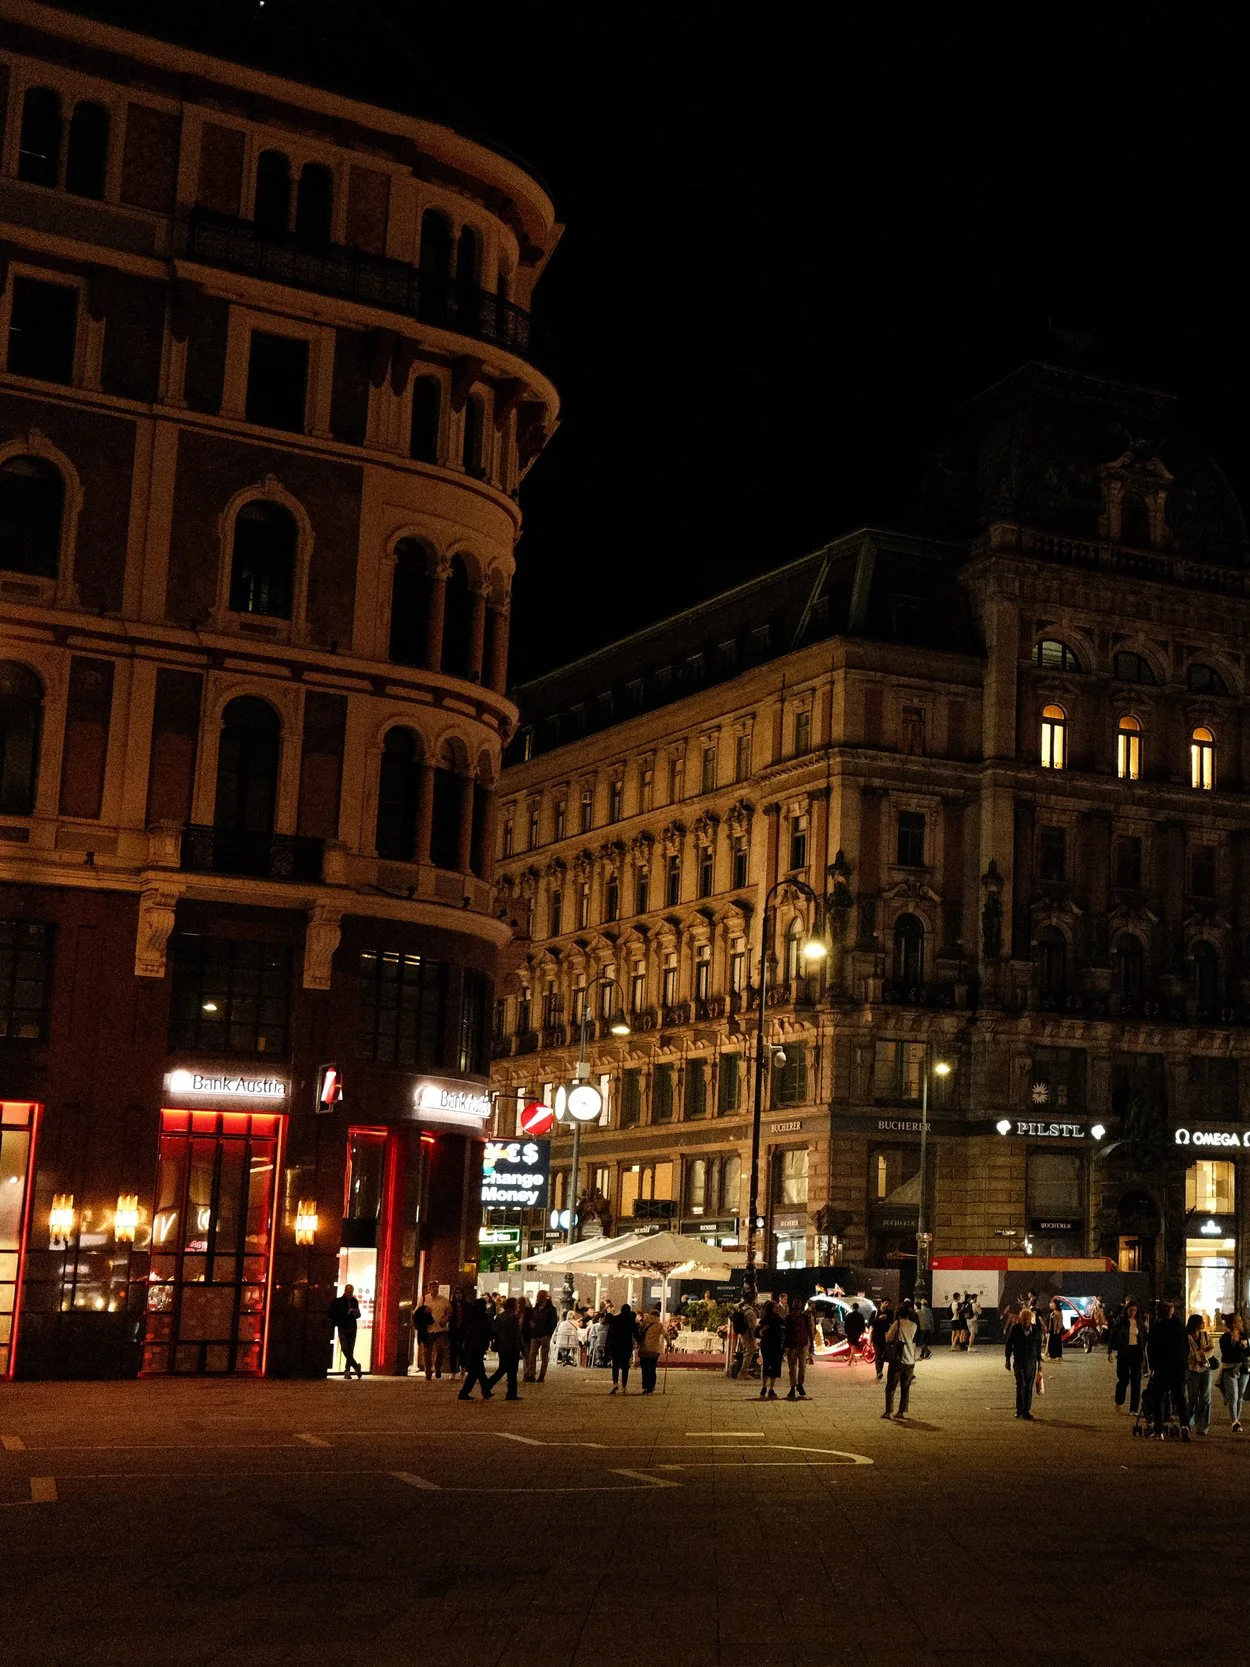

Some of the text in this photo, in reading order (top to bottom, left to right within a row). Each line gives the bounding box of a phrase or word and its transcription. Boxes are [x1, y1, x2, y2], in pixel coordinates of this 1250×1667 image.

[193, 1075, 286, 1094] Bank Austria
[440, 1089, 466, 1110] Bank
[771, 1121, 802, 1133] BUCHERER
[878, 1120, 932, 1132] BUCHERER
[1016, 1122, 1085, 1138] PILSTL
[1192, 1132, 1241, 1147] OMEGA
[481, 1186, 539, 1205] Money
